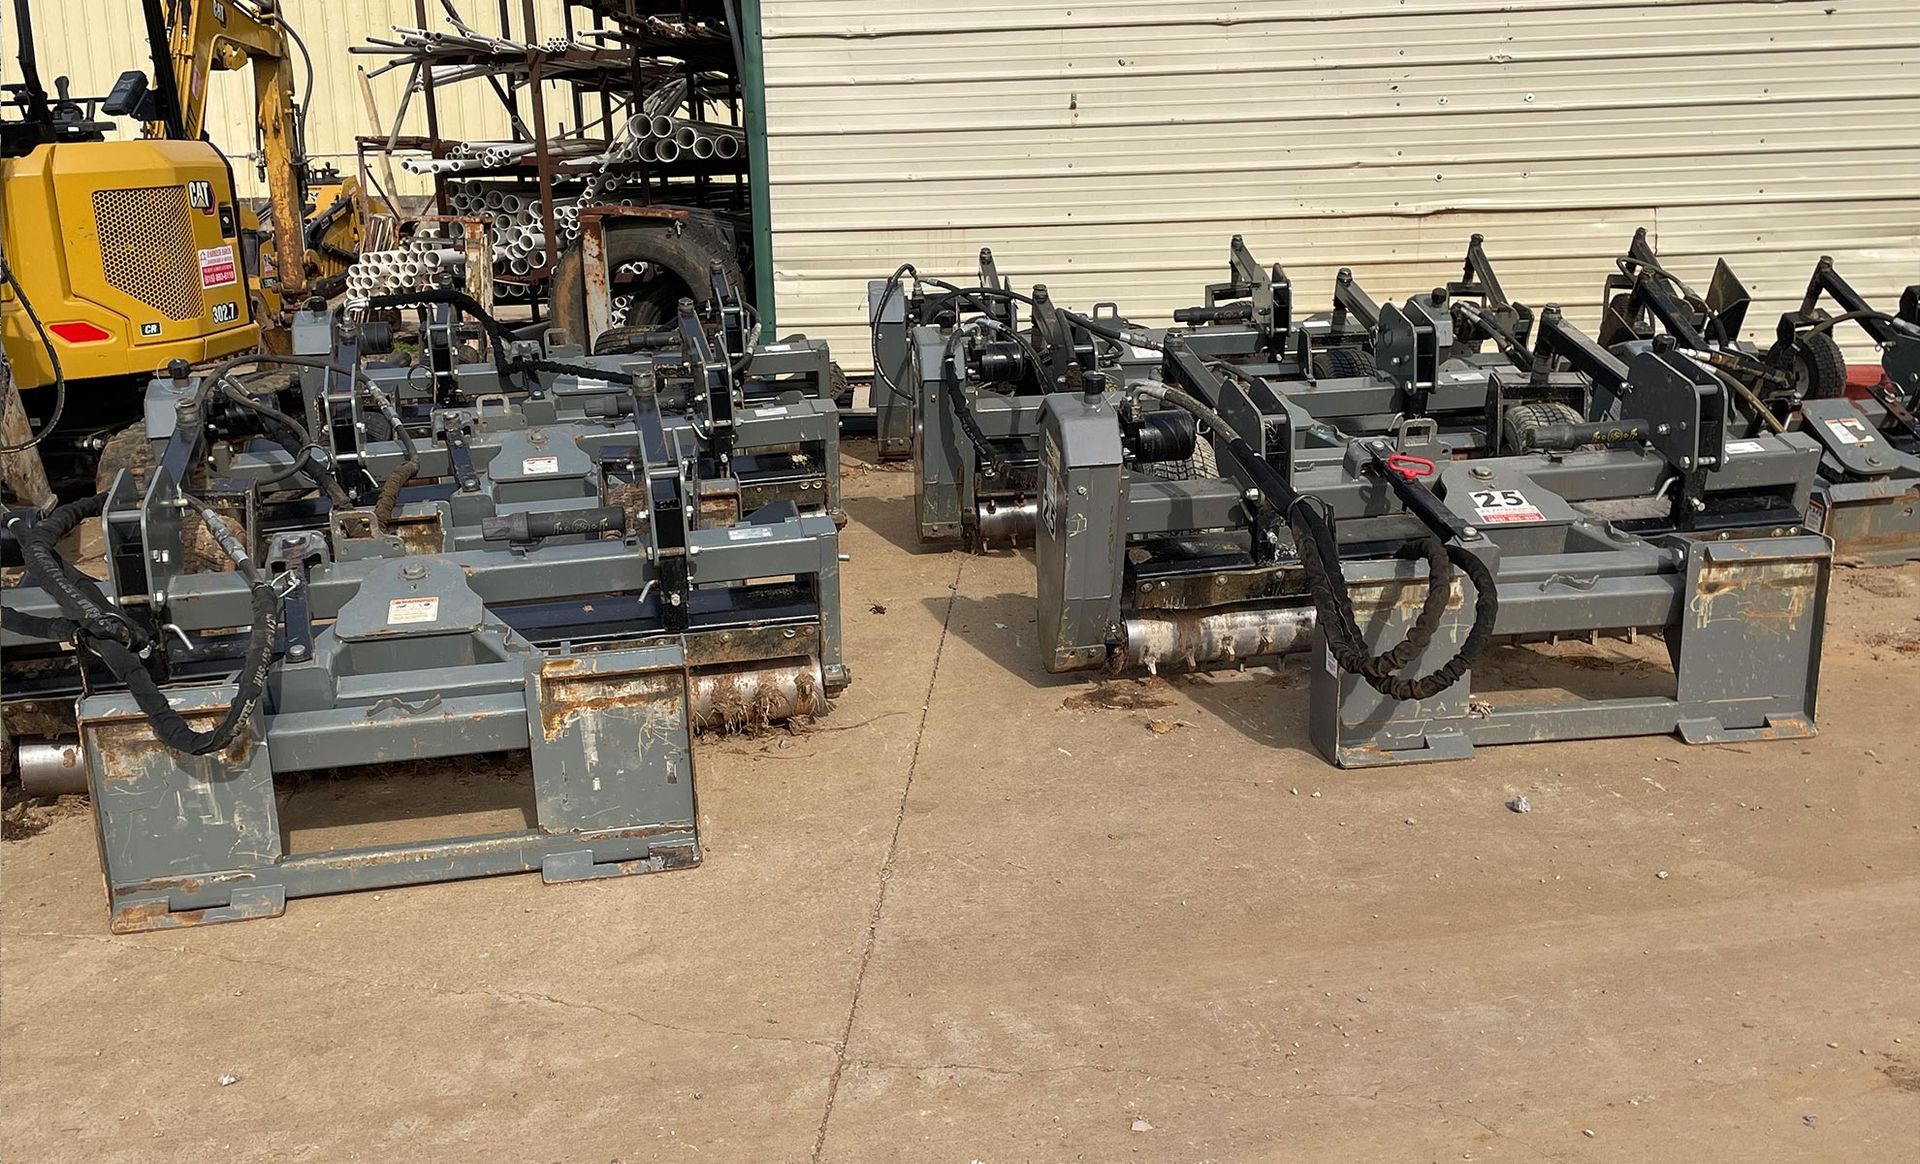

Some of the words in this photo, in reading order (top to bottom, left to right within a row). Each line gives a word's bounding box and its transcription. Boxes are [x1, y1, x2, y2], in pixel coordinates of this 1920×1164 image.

[188, 181, 210, 208] CAT
[212, 303, 235, 323] 302.7
[144, 324, 158, 334] CR
[1474, 491, 1524, 508] 25
